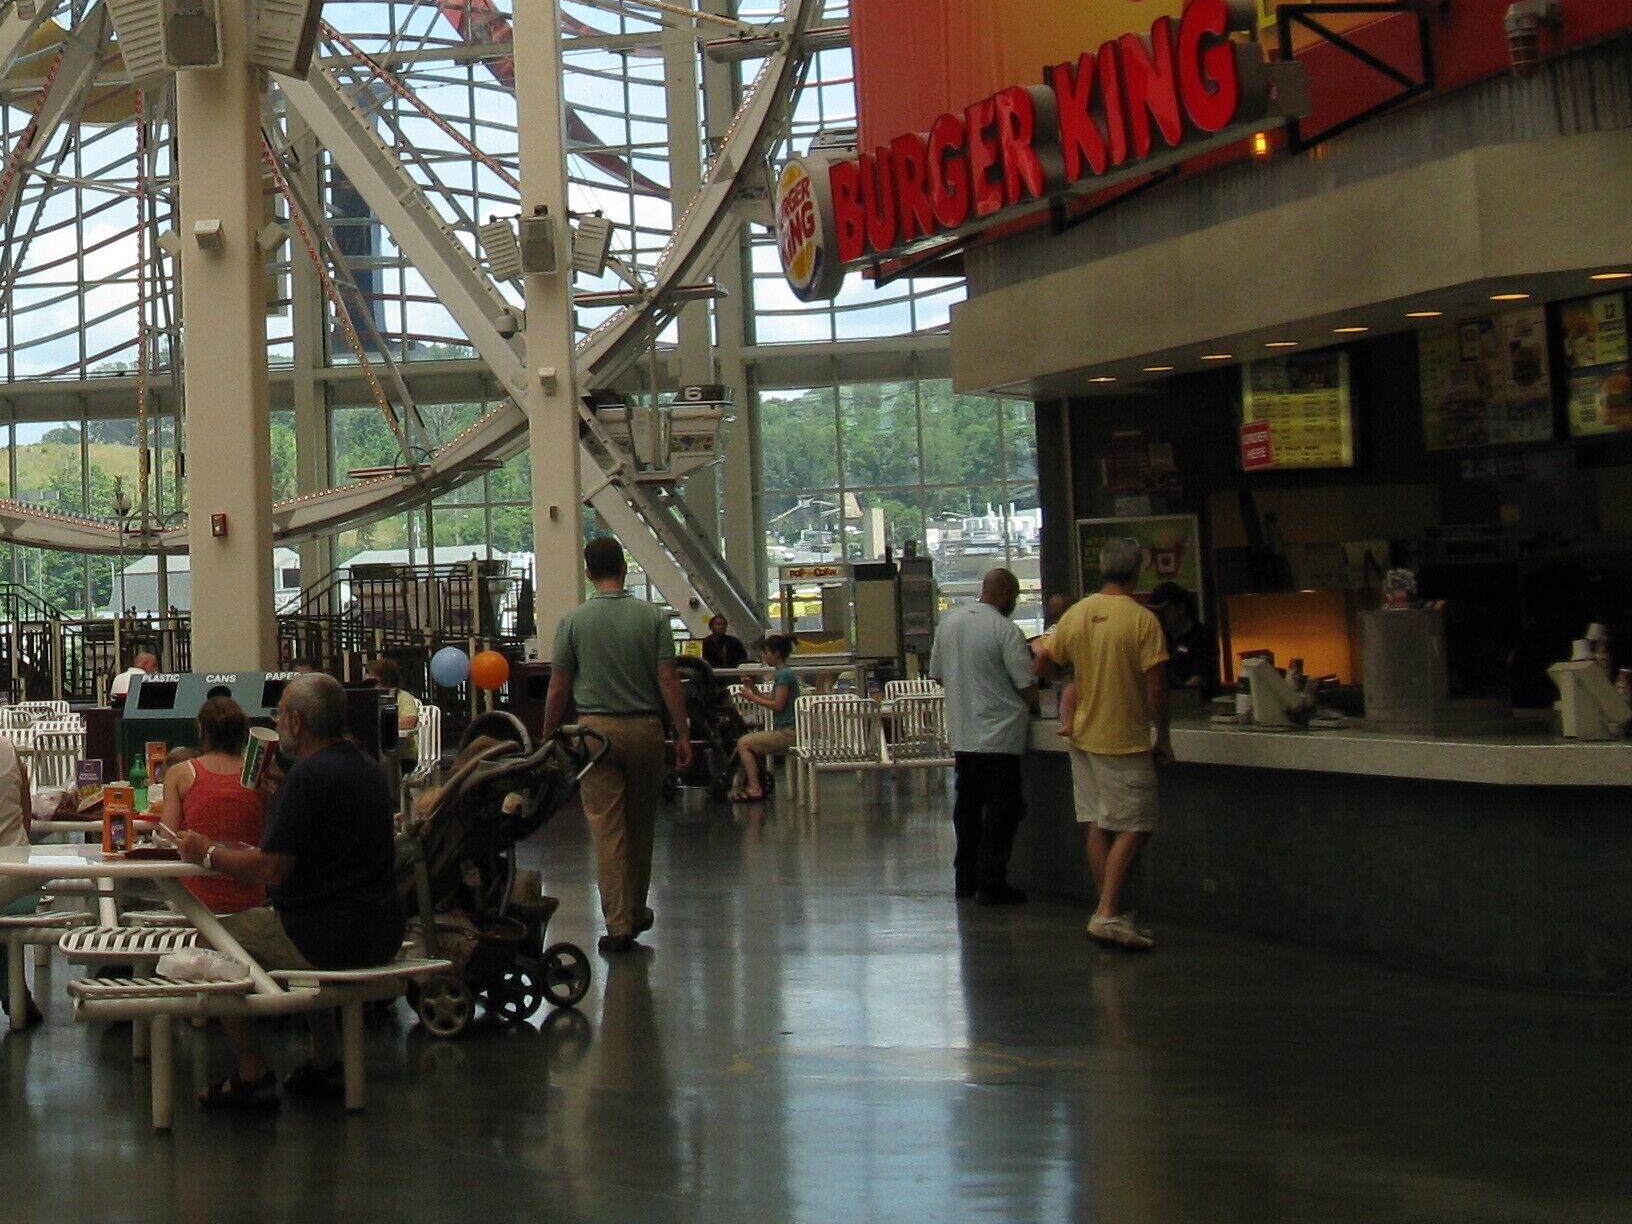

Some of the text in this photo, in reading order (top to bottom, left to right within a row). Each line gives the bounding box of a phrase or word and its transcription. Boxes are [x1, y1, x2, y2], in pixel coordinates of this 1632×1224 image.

[829, 86, 1046, 263] BURGER
[684, 386, 702, 401] 6
[142, 674, 180, 683] PLASTIC
[205, 674, 237, 683] CANS
